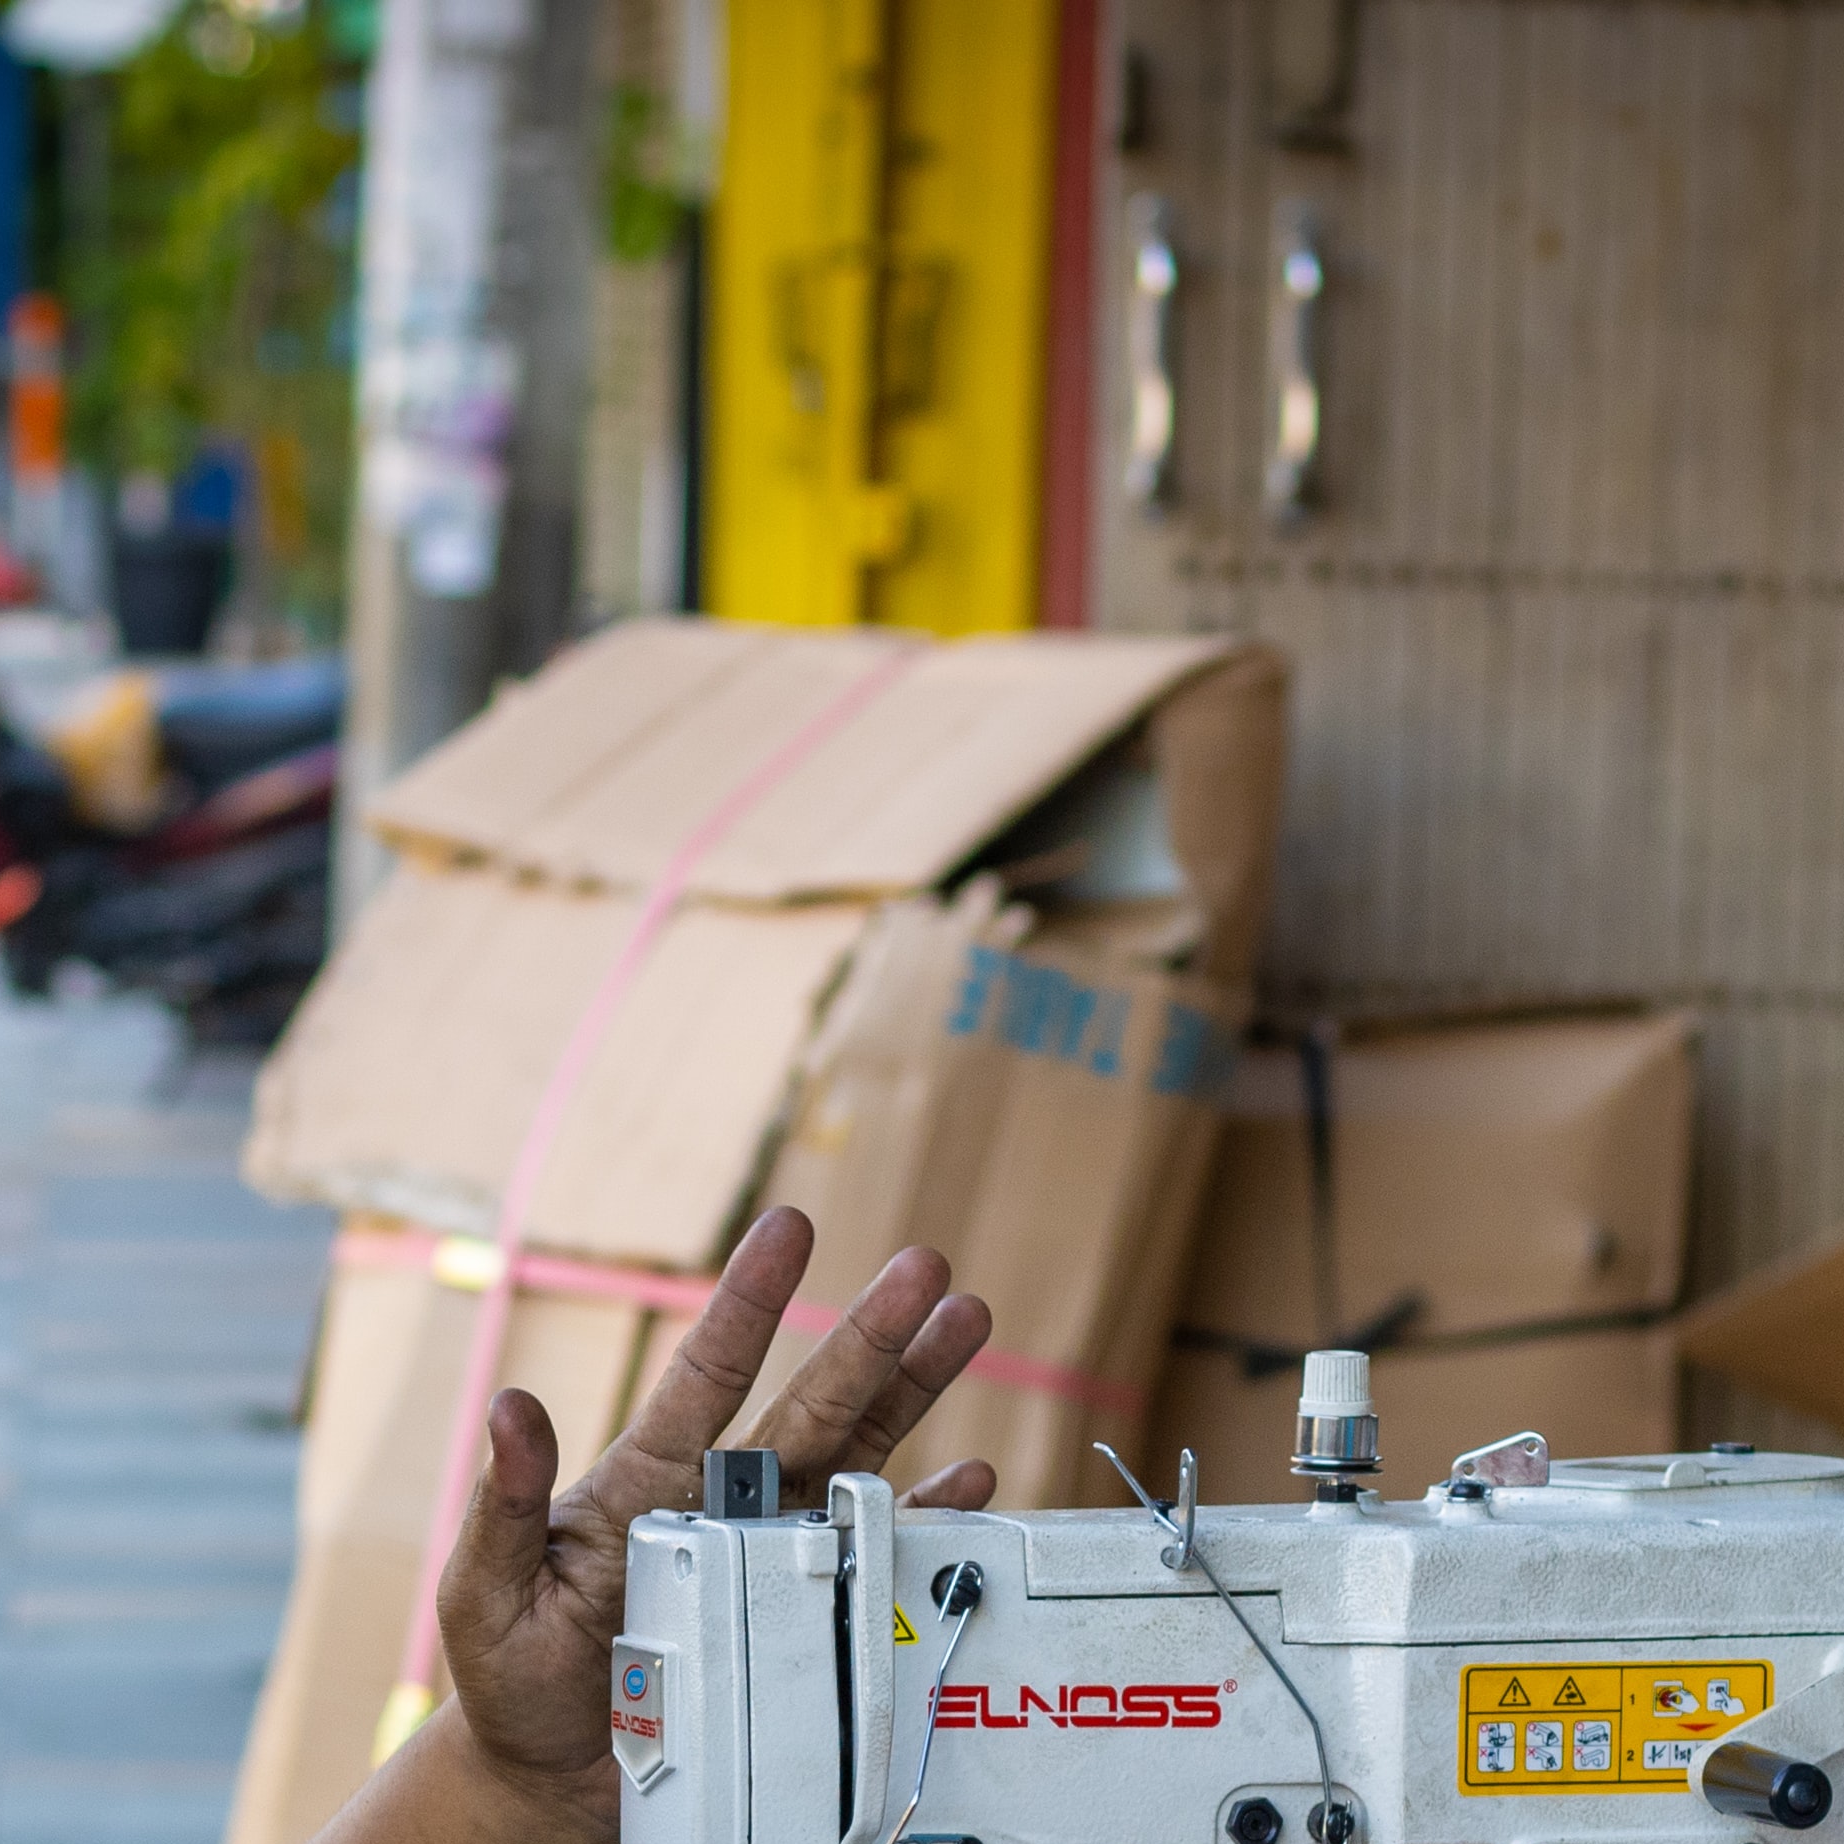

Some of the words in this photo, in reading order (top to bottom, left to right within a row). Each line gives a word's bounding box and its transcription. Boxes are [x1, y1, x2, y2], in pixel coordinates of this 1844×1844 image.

[928, 1684, 1221, 1729] ELNOSS
[612, 1710, 656, 1739] ELNOSS
[1626, 1750, 1634, 1762] 2
